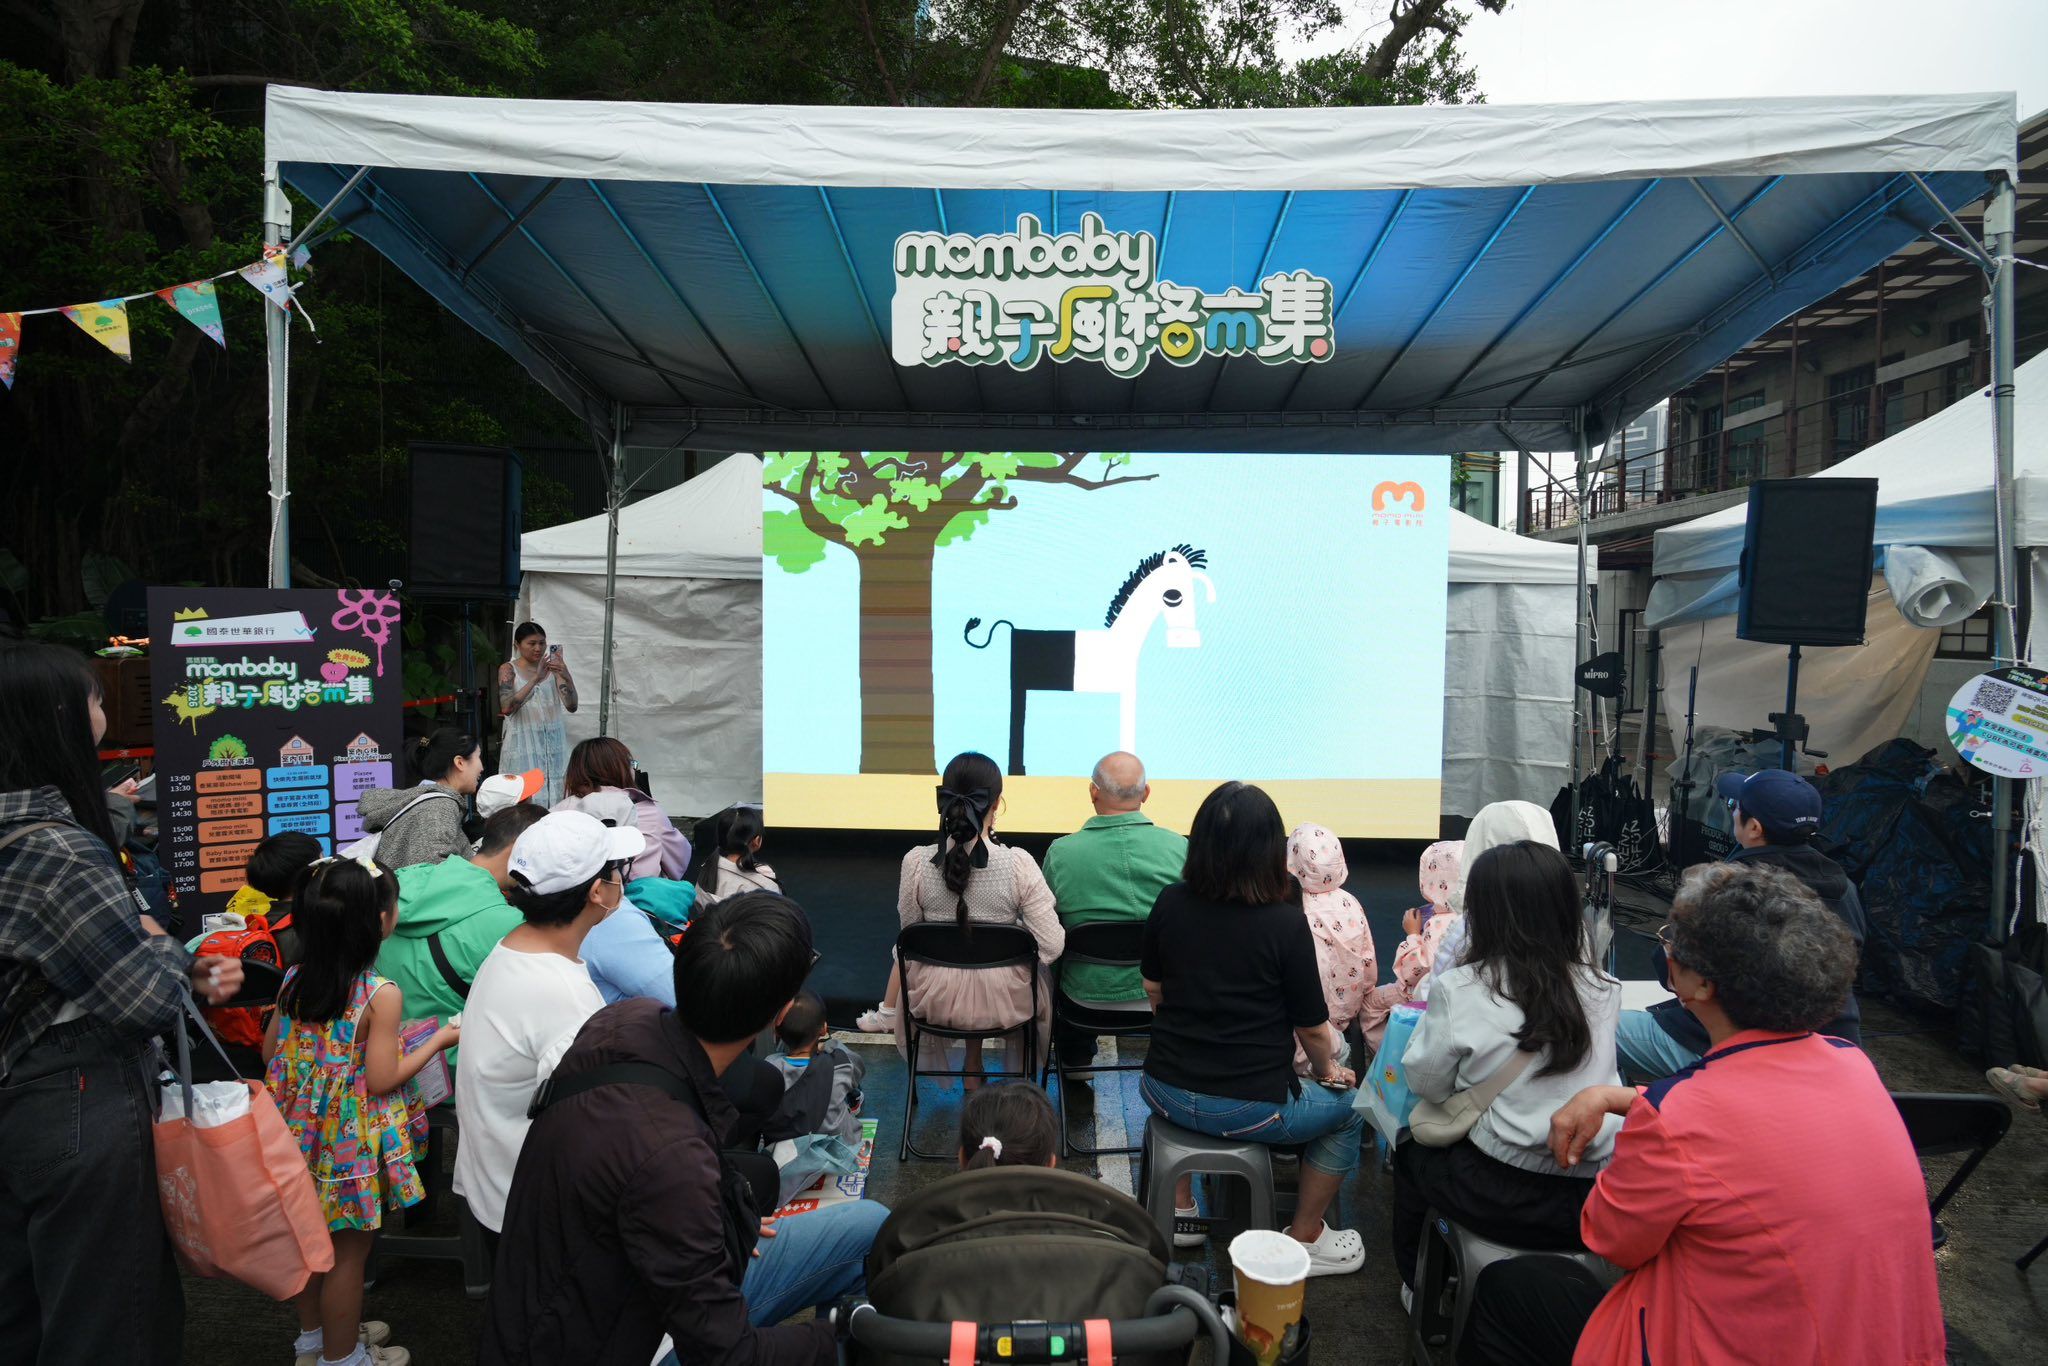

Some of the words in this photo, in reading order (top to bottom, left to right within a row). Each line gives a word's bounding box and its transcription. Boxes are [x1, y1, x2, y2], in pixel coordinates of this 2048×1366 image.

[896, 213, 1153, 288] mombaby
[206, 626, 275, 636] 國泰世華銀行
[186, 656, 297, 681] mombaby
[188, 685, 198, 707] 2026
[171, 800, 192, 808] 14:00
[173, 835, 193, 843] 15:30
